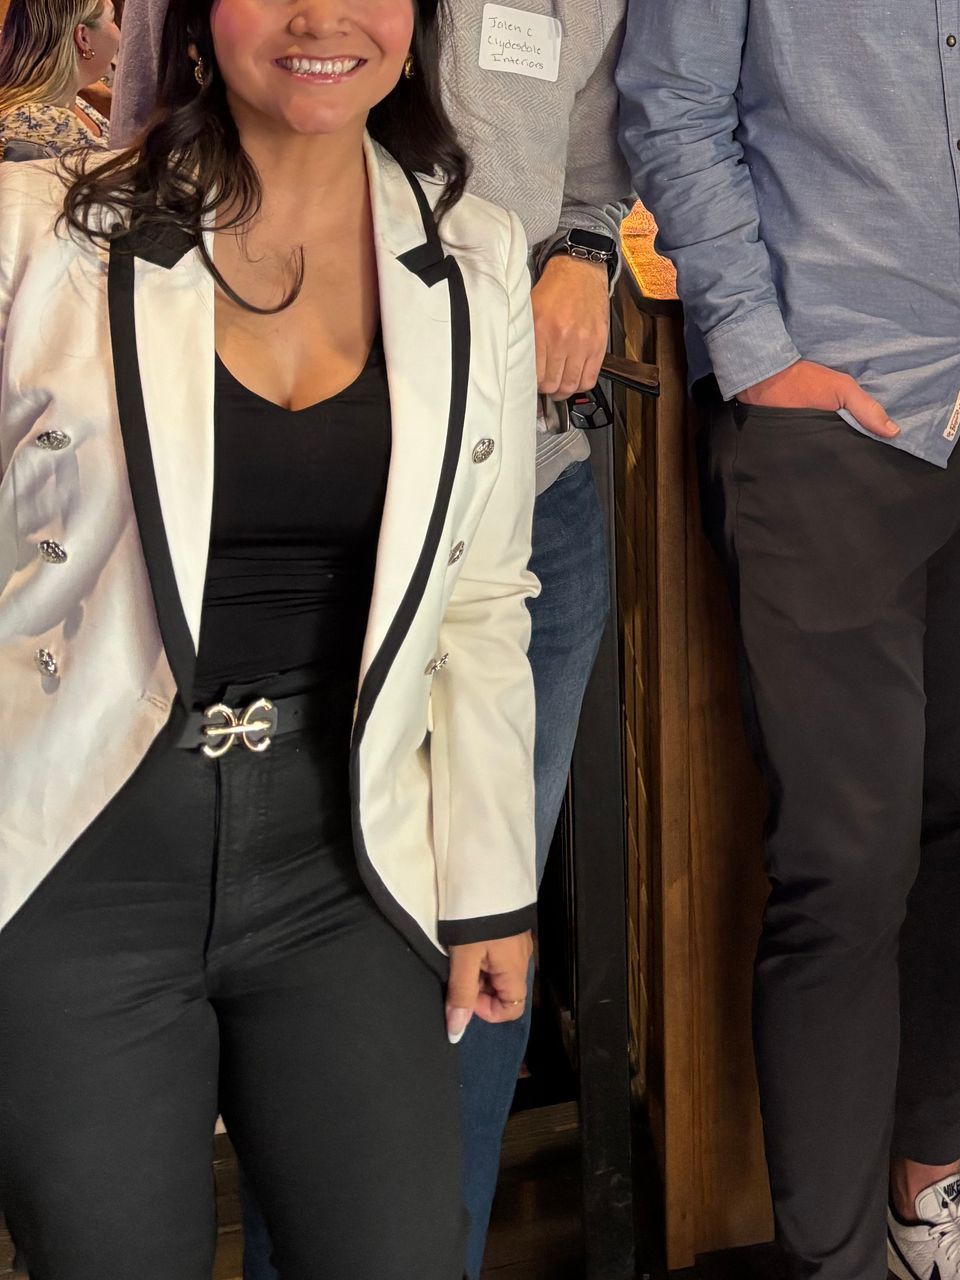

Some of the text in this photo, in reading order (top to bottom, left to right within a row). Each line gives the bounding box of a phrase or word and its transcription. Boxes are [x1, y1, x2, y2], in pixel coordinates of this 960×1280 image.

[488, 16, 522, 33] Jalen
[487, 35, 542, 56] Clydesdale
[490, 53, 544, 70] Interiors
